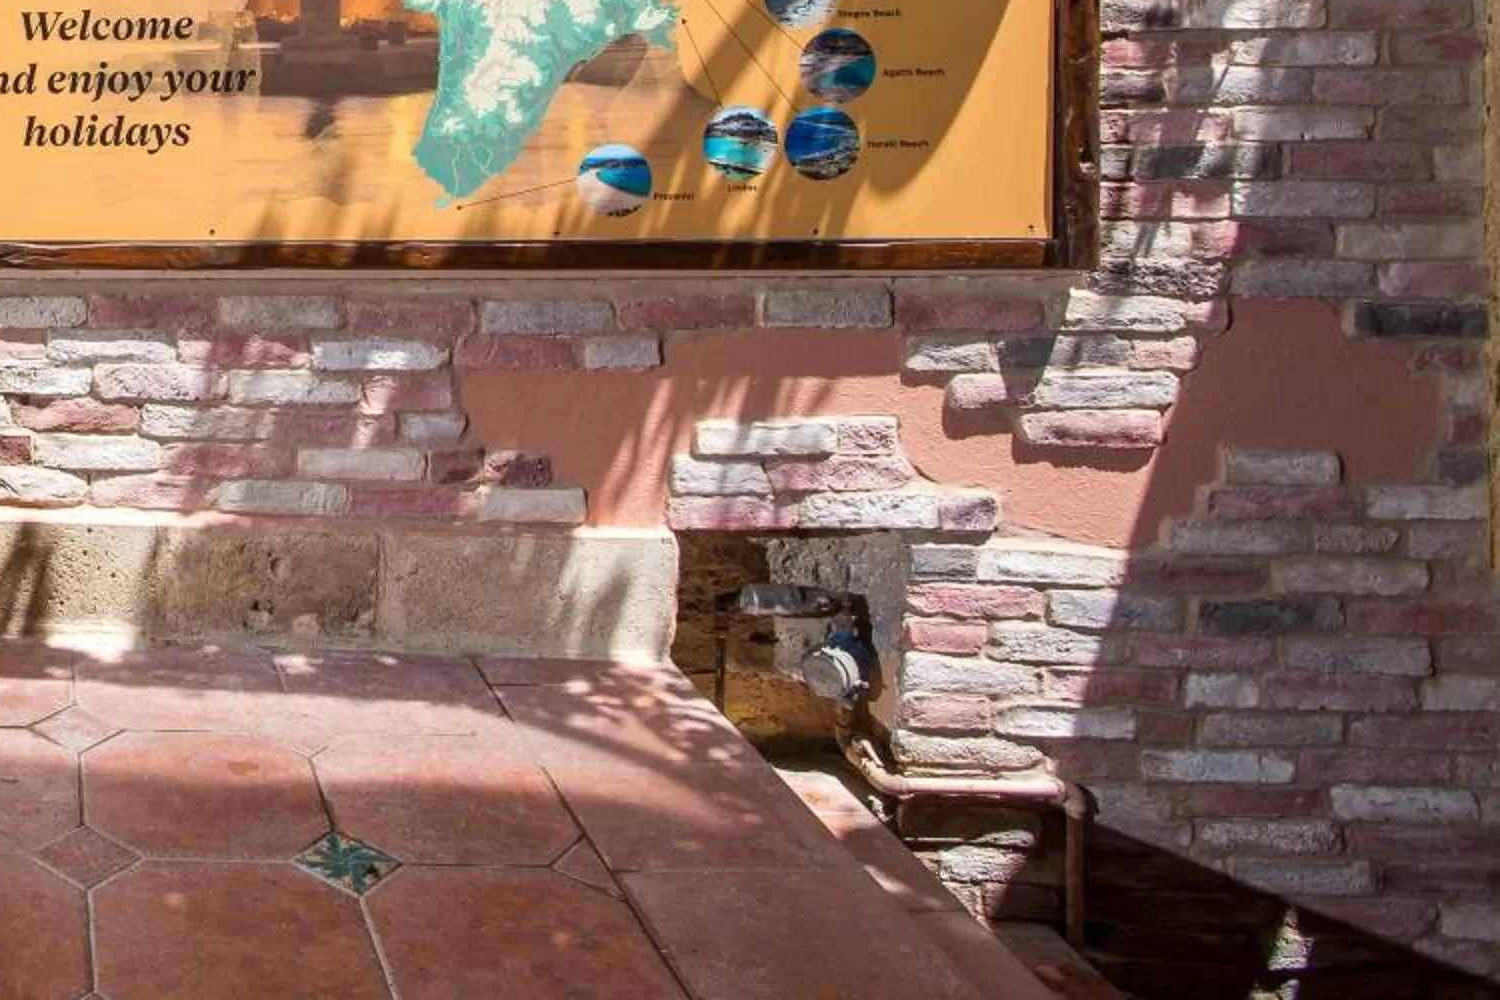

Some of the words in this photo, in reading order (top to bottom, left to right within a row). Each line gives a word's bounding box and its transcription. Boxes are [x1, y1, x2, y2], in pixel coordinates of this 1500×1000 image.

[21, 9, 194, 41] Welcome
[47, 61, 153, 102] enjoy
[160, 67, 257, 101] your
[23, 114, 191, 154] holidays
